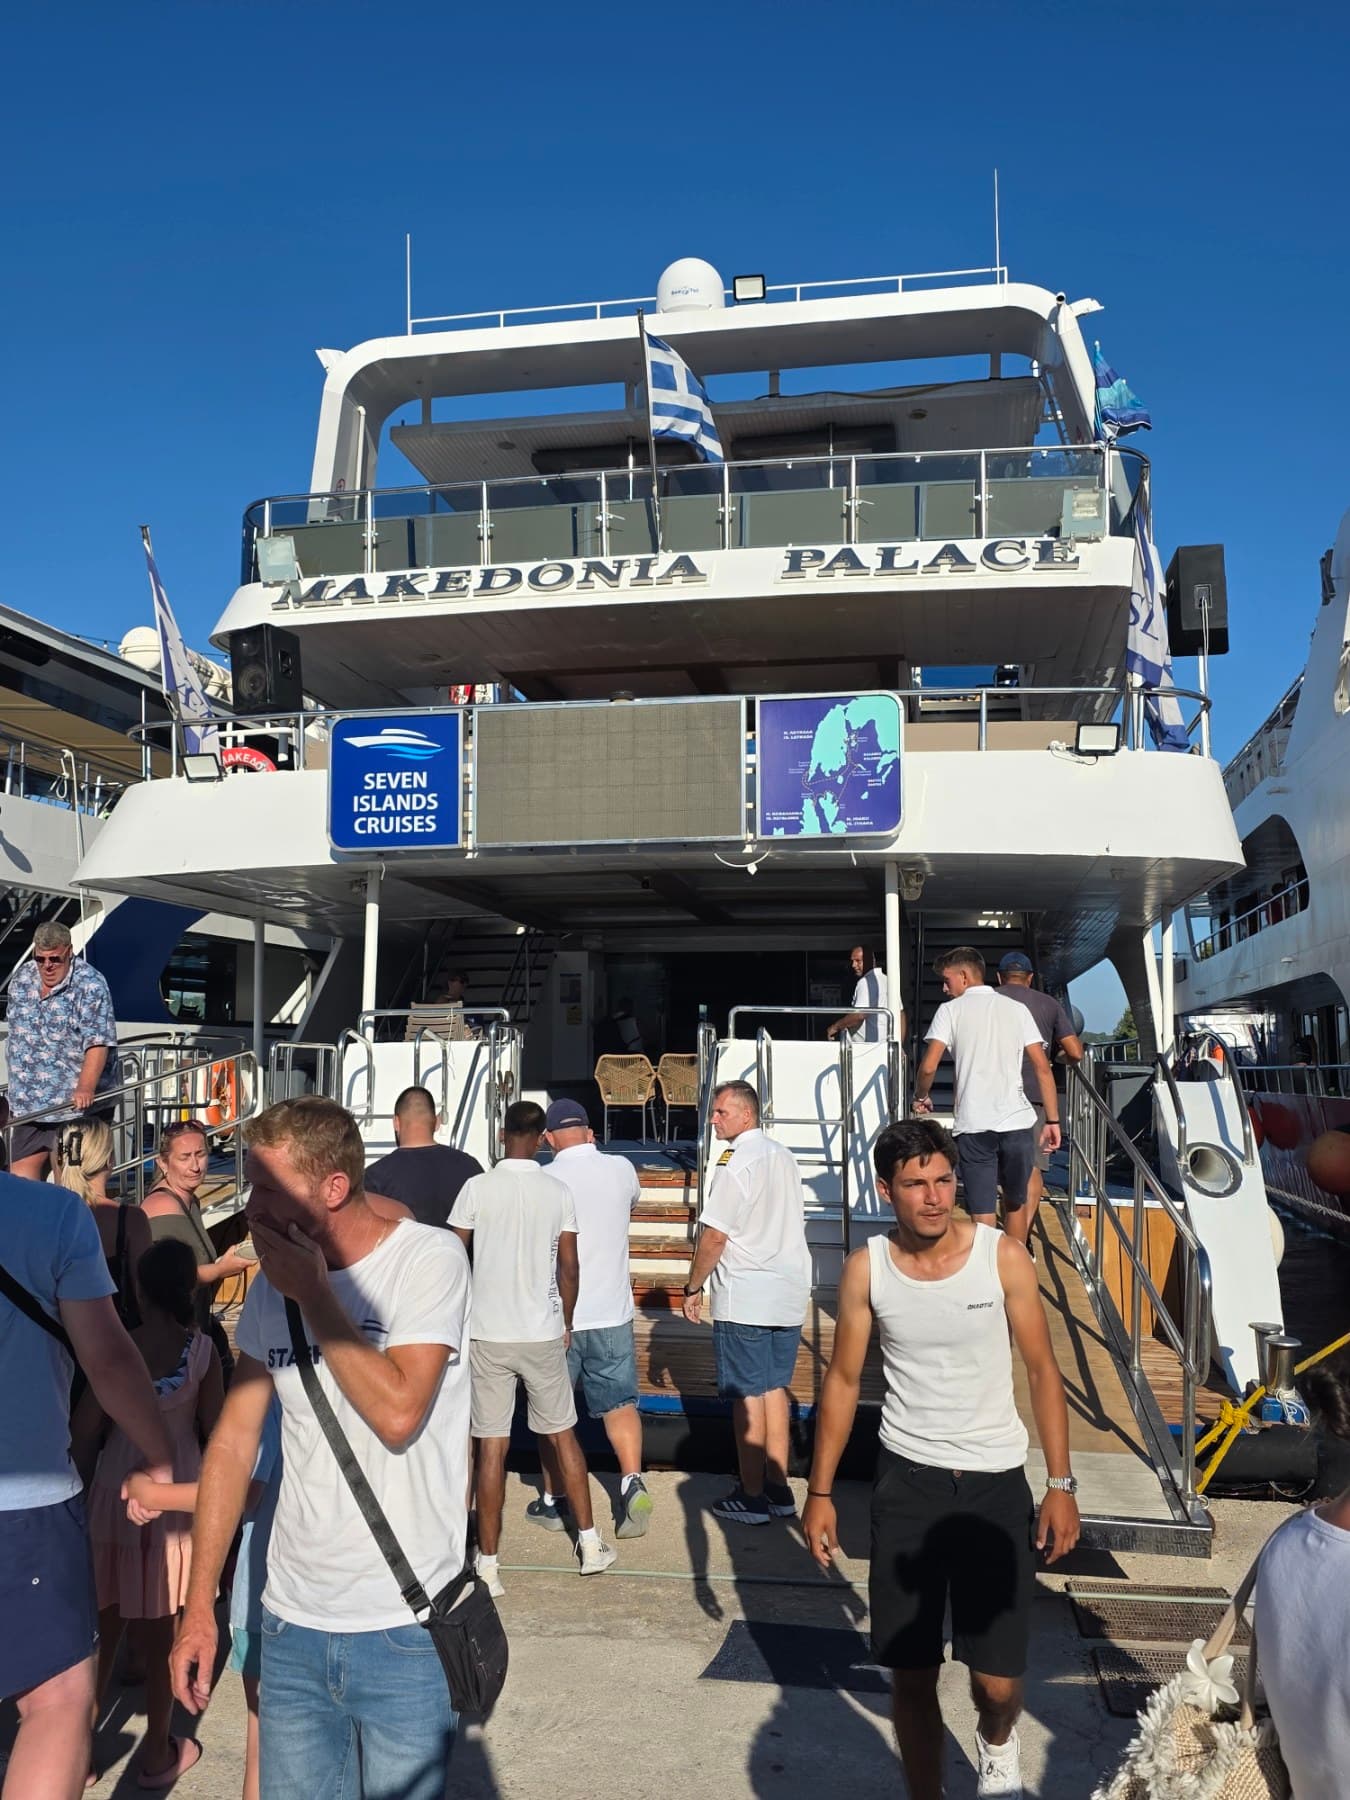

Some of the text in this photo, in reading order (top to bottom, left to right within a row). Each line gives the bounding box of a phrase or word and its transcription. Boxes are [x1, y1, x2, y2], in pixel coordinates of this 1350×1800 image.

[271, 539, 1080, 611] MAKEDONIA PALACE
[364, 771, 427, 790] SEVEN
[353, 793, 439, 812] ISLANDS
[353, 815, 437, 834] CRUISES
